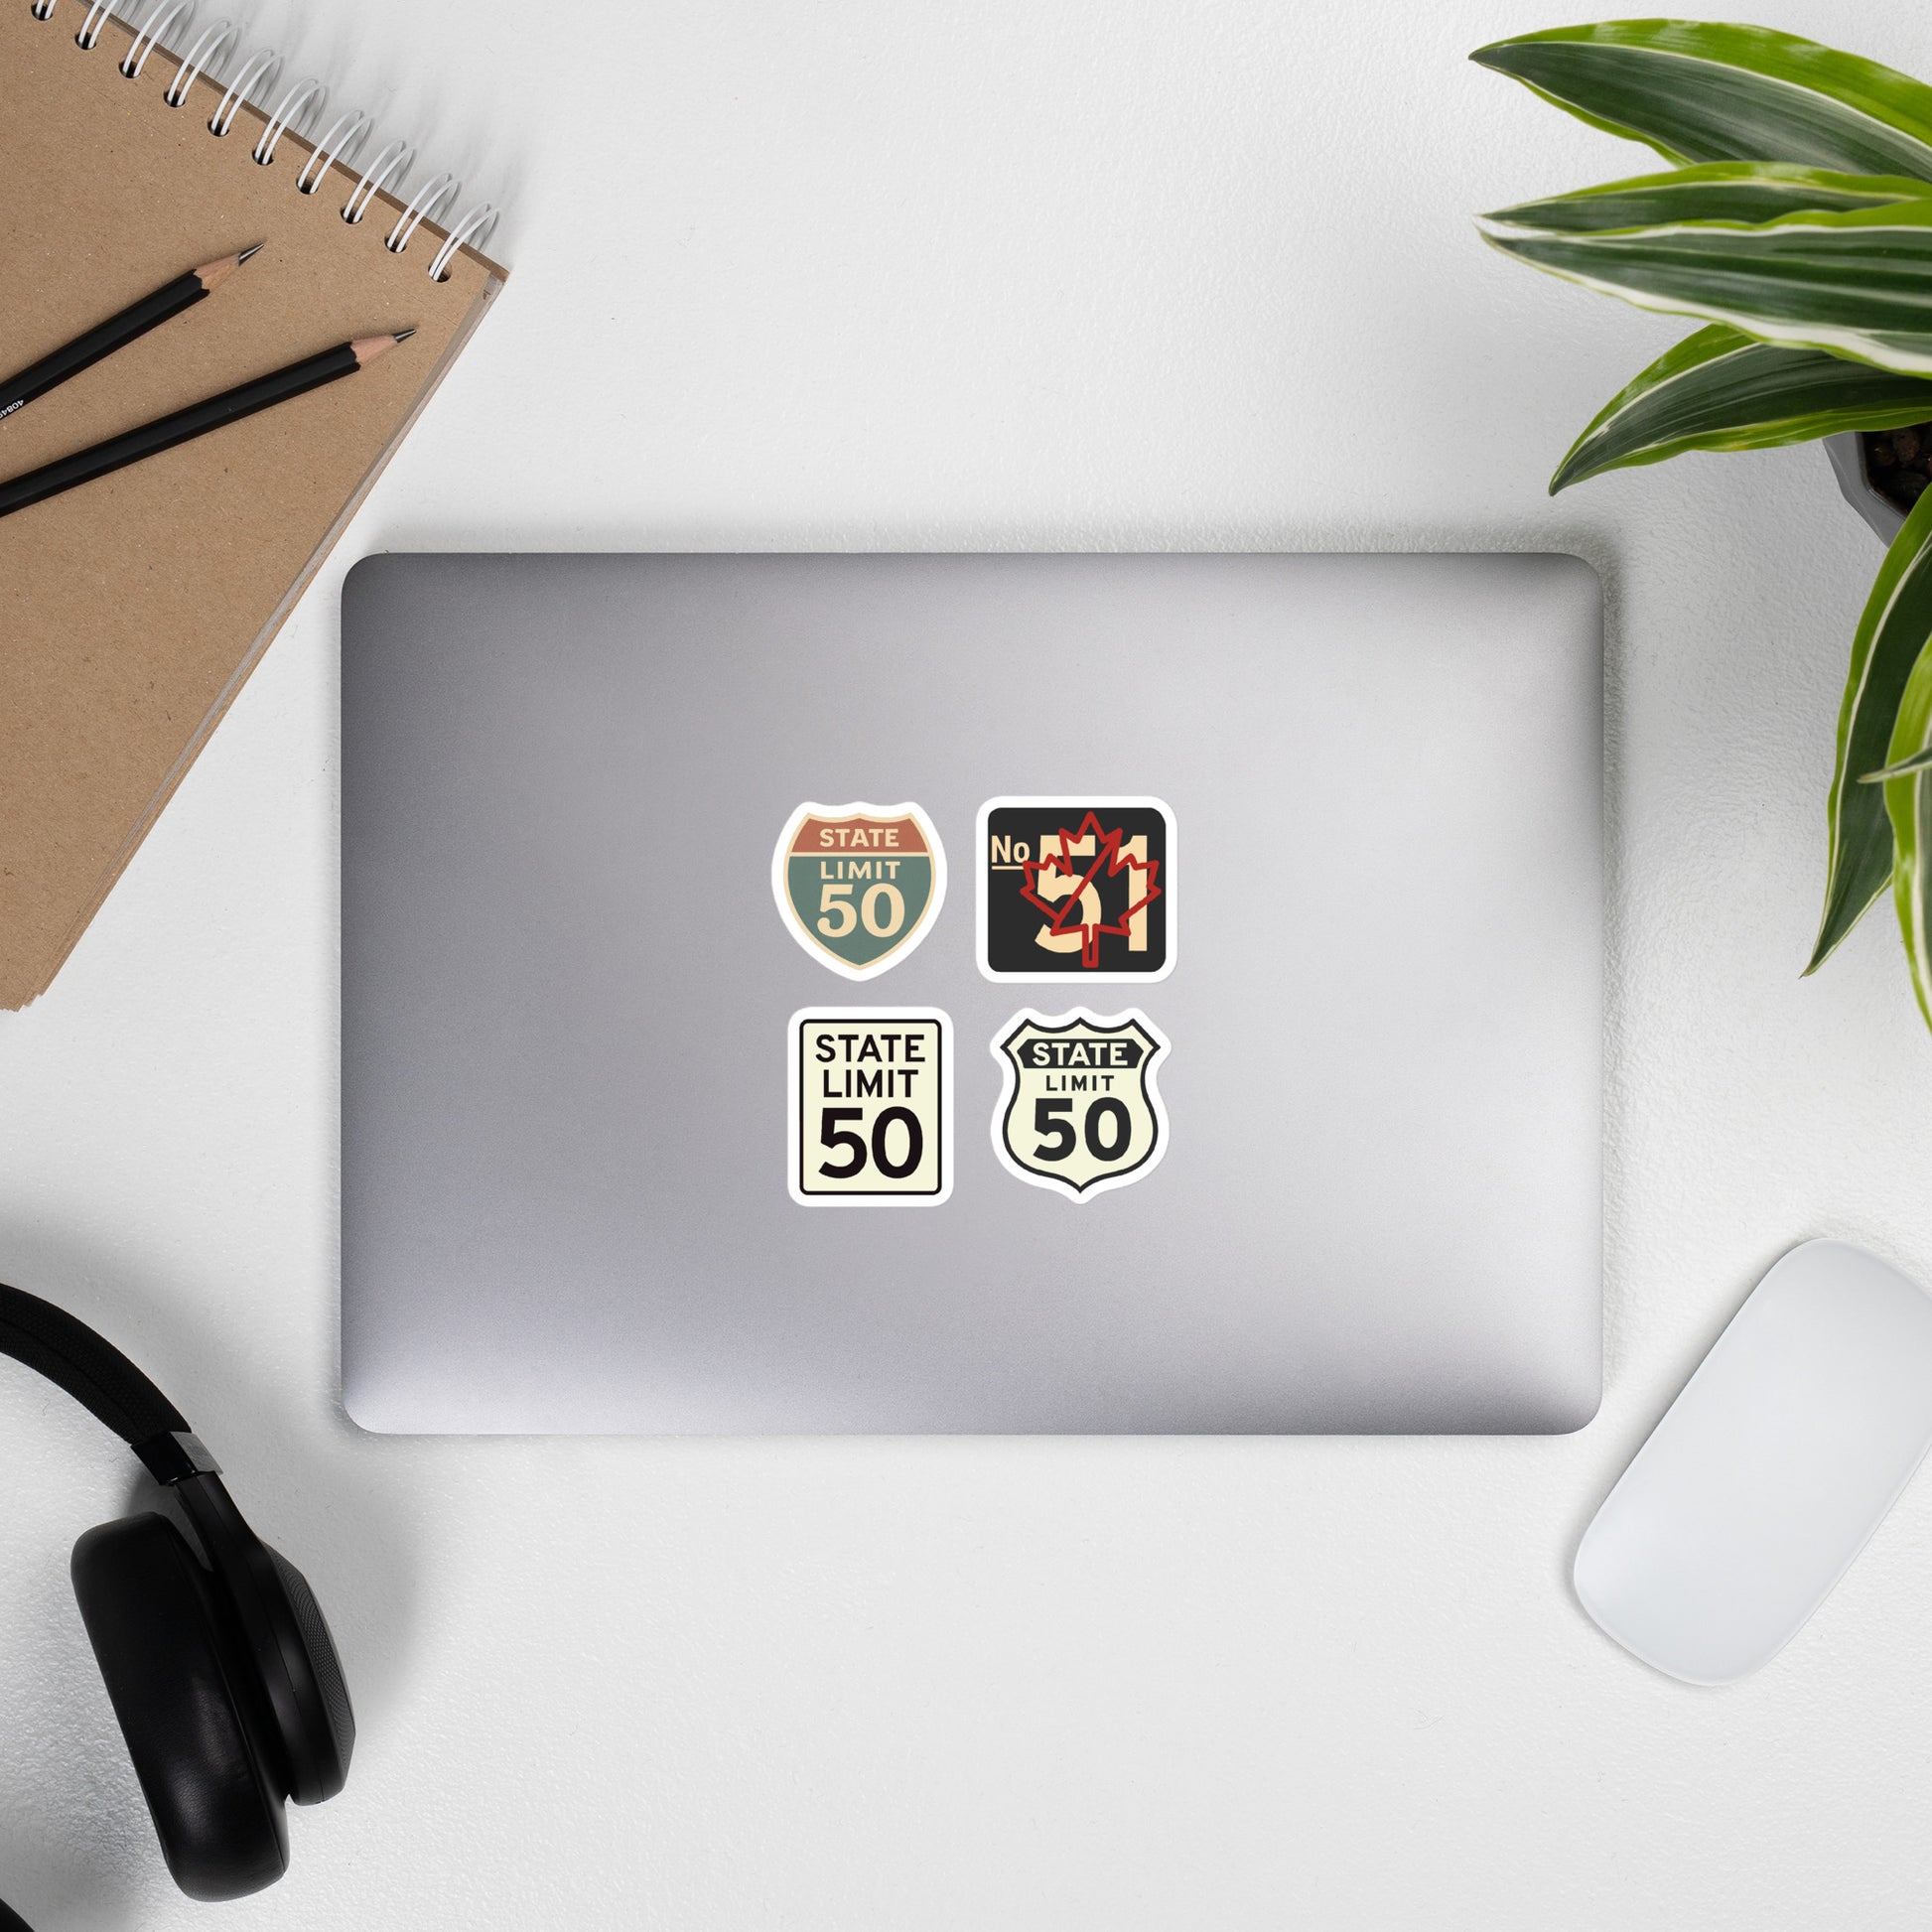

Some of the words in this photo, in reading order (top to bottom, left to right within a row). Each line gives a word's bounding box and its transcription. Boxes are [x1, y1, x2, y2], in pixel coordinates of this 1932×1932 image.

[819, 828, 899, 847] STATE
[820, 861, 900, 880] LIMIT
[991, 835, 1031, 863] No
[1035, 835, 1148, 953] 51
[816, 883, 905, 937] 50
[815, 1034, 925, 1062] STATE
[1032, 1042, 1128, 1066] STATE
[823, 1069, 919, 1098] LIMIT
[1045, 1075, 1114, 1091] LIMIT
[818, 1106, 923, 1179] 50
[1033, 1097, 1132, 1162] 50
